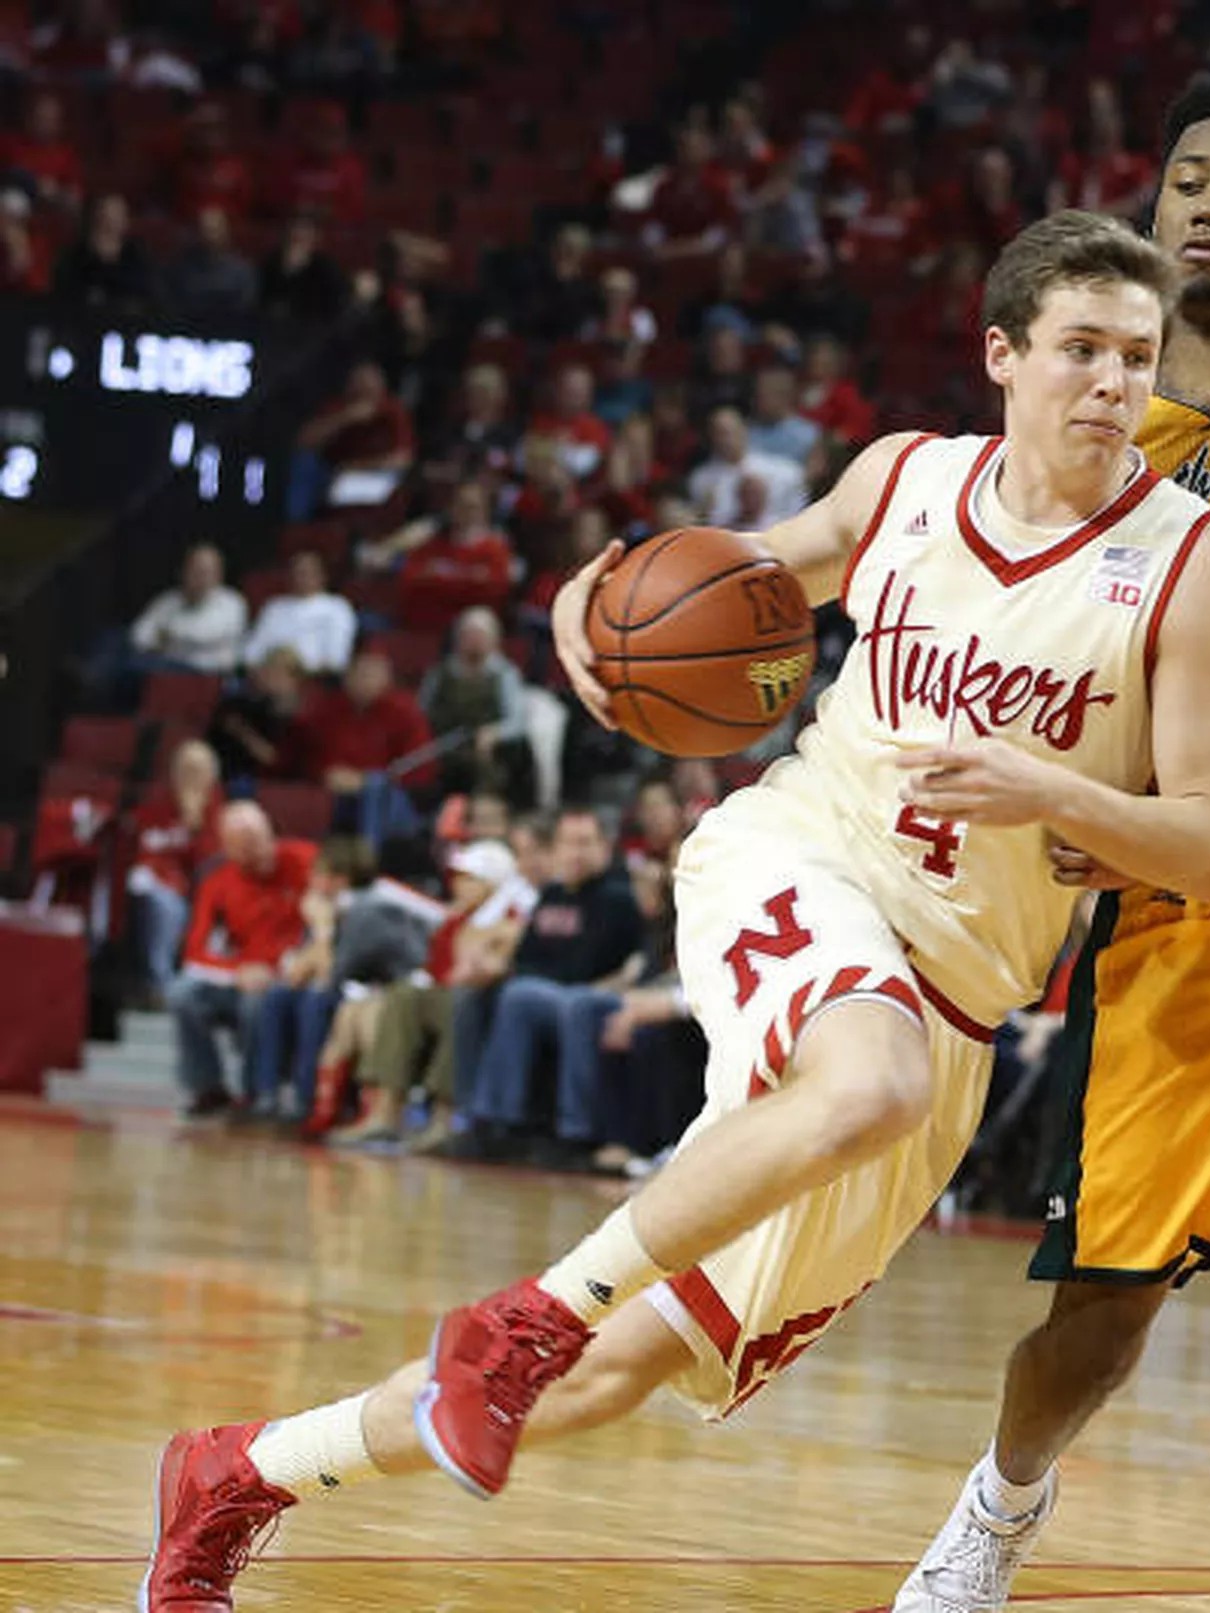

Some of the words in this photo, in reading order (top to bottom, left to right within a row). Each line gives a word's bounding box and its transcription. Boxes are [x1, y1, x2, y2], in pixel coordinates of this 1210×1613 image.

[100, 330, 253, 398] LIONS
[861, 569, 1117, 750] Huskers
[895, 803, 960, 879] 4
[723, 885, 813, 1011] N
